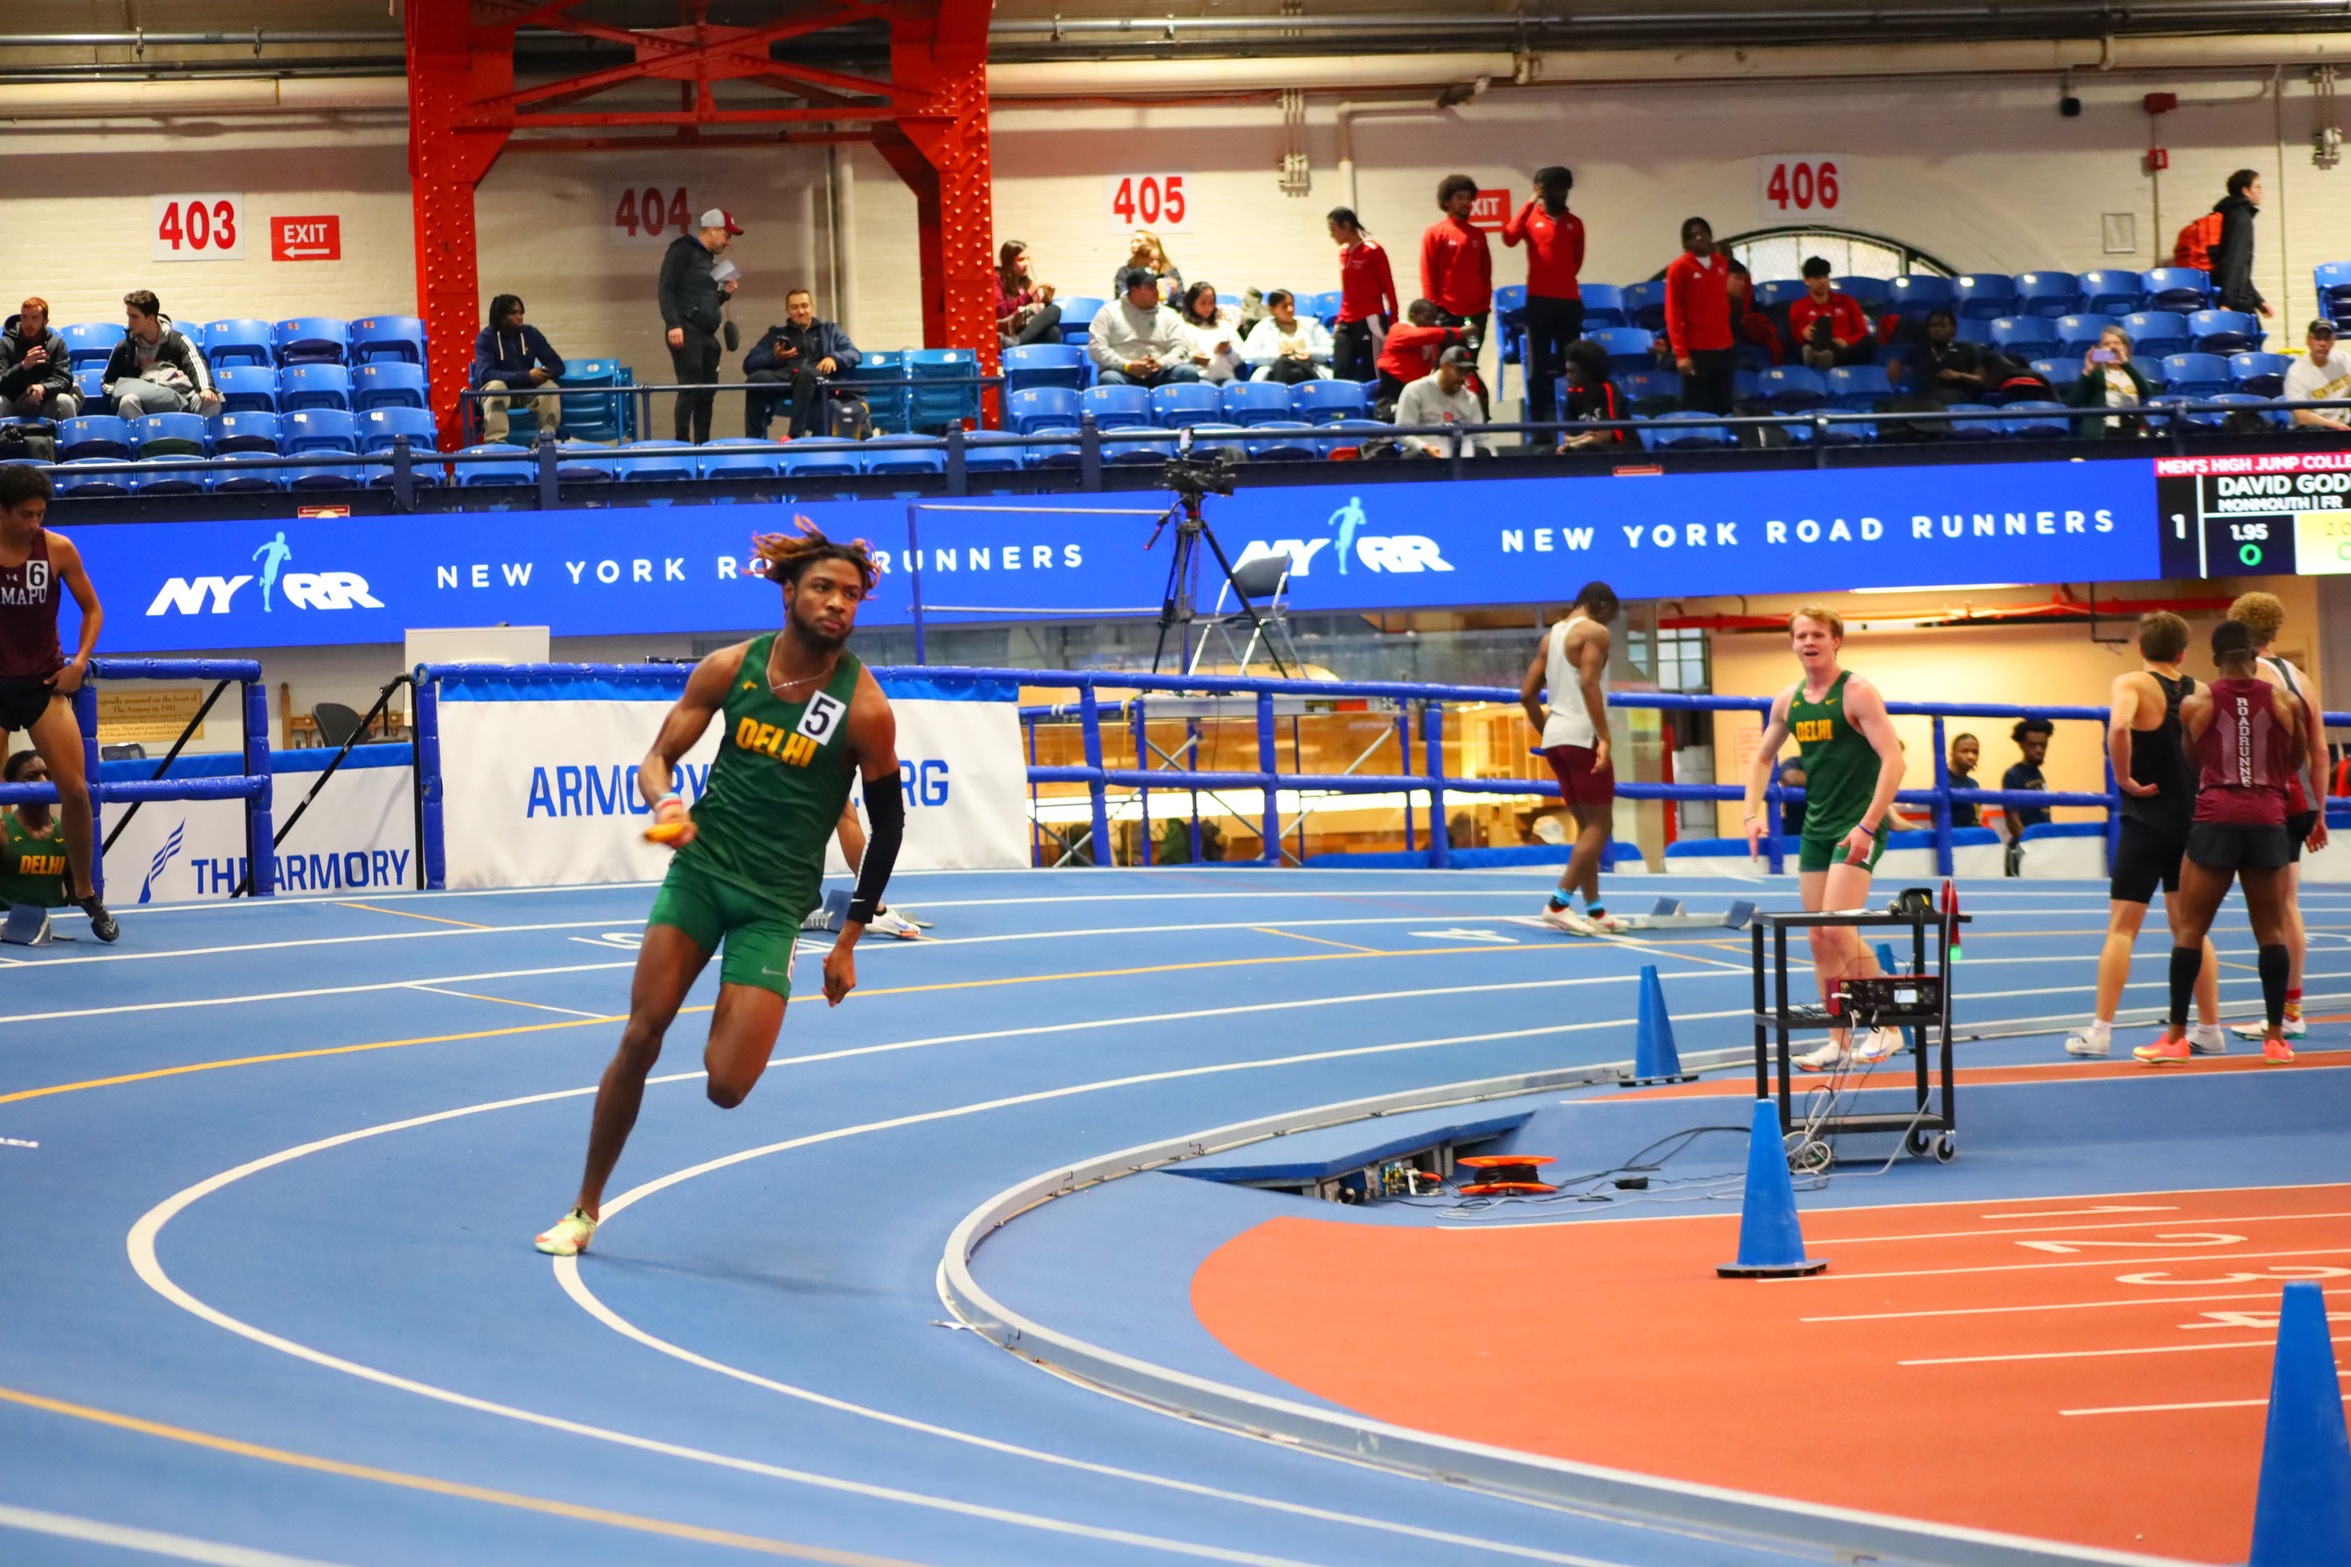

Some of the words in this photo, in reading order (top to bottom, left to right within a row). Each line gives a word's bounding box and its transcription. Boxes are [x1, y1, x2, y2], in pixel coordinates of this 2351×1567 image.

[1766, 161, 1839, 210] 406
[615, 187, 692, 237] 404
[1113, 176, 1185, 224] 405
[1470, 197, 1499, 216] XIT
[159, 200, 236, 250] 403
[283, 224, 327, 244] EXIT
[2156, 459, 2208, 474] MEN'S
[2211, 458, 2251, 472] HIGH
[2255, 455, 2299, 471] JUMP
[2217, 475, 2292, 496] DAVID
[2296, 473, 2351, 493] GOD
[2217, 496, 2310, 512] MONMOUTH
[2321, 495, 2343, 509] FR
[1501, 527, 1594, 553] NEW
[1622, 522, 1738, 549] YORK
[1766, 517, 1883, 544] ROAD
[1912, 510, 2114, 539] RUNNERS
[2171, 514, 2186, 539] 1
[2229, 523, 2269, 541] 1.95
[29, 562, 45, 587] 6
[437, 562, 533, 589] NEW
[565, 557, 686, 585] YORK
[717, 556, 767, 579] RO
[871, 544, 1083, 574] RUNNERS
[97, 696, 123, 706] riginally
[805, 696, 837, 736] 5
[736, 716, 818, 768] DELHI
[1796, 718, 1833, 742] DELHI
[18, 855, 66, 875] DELHI
